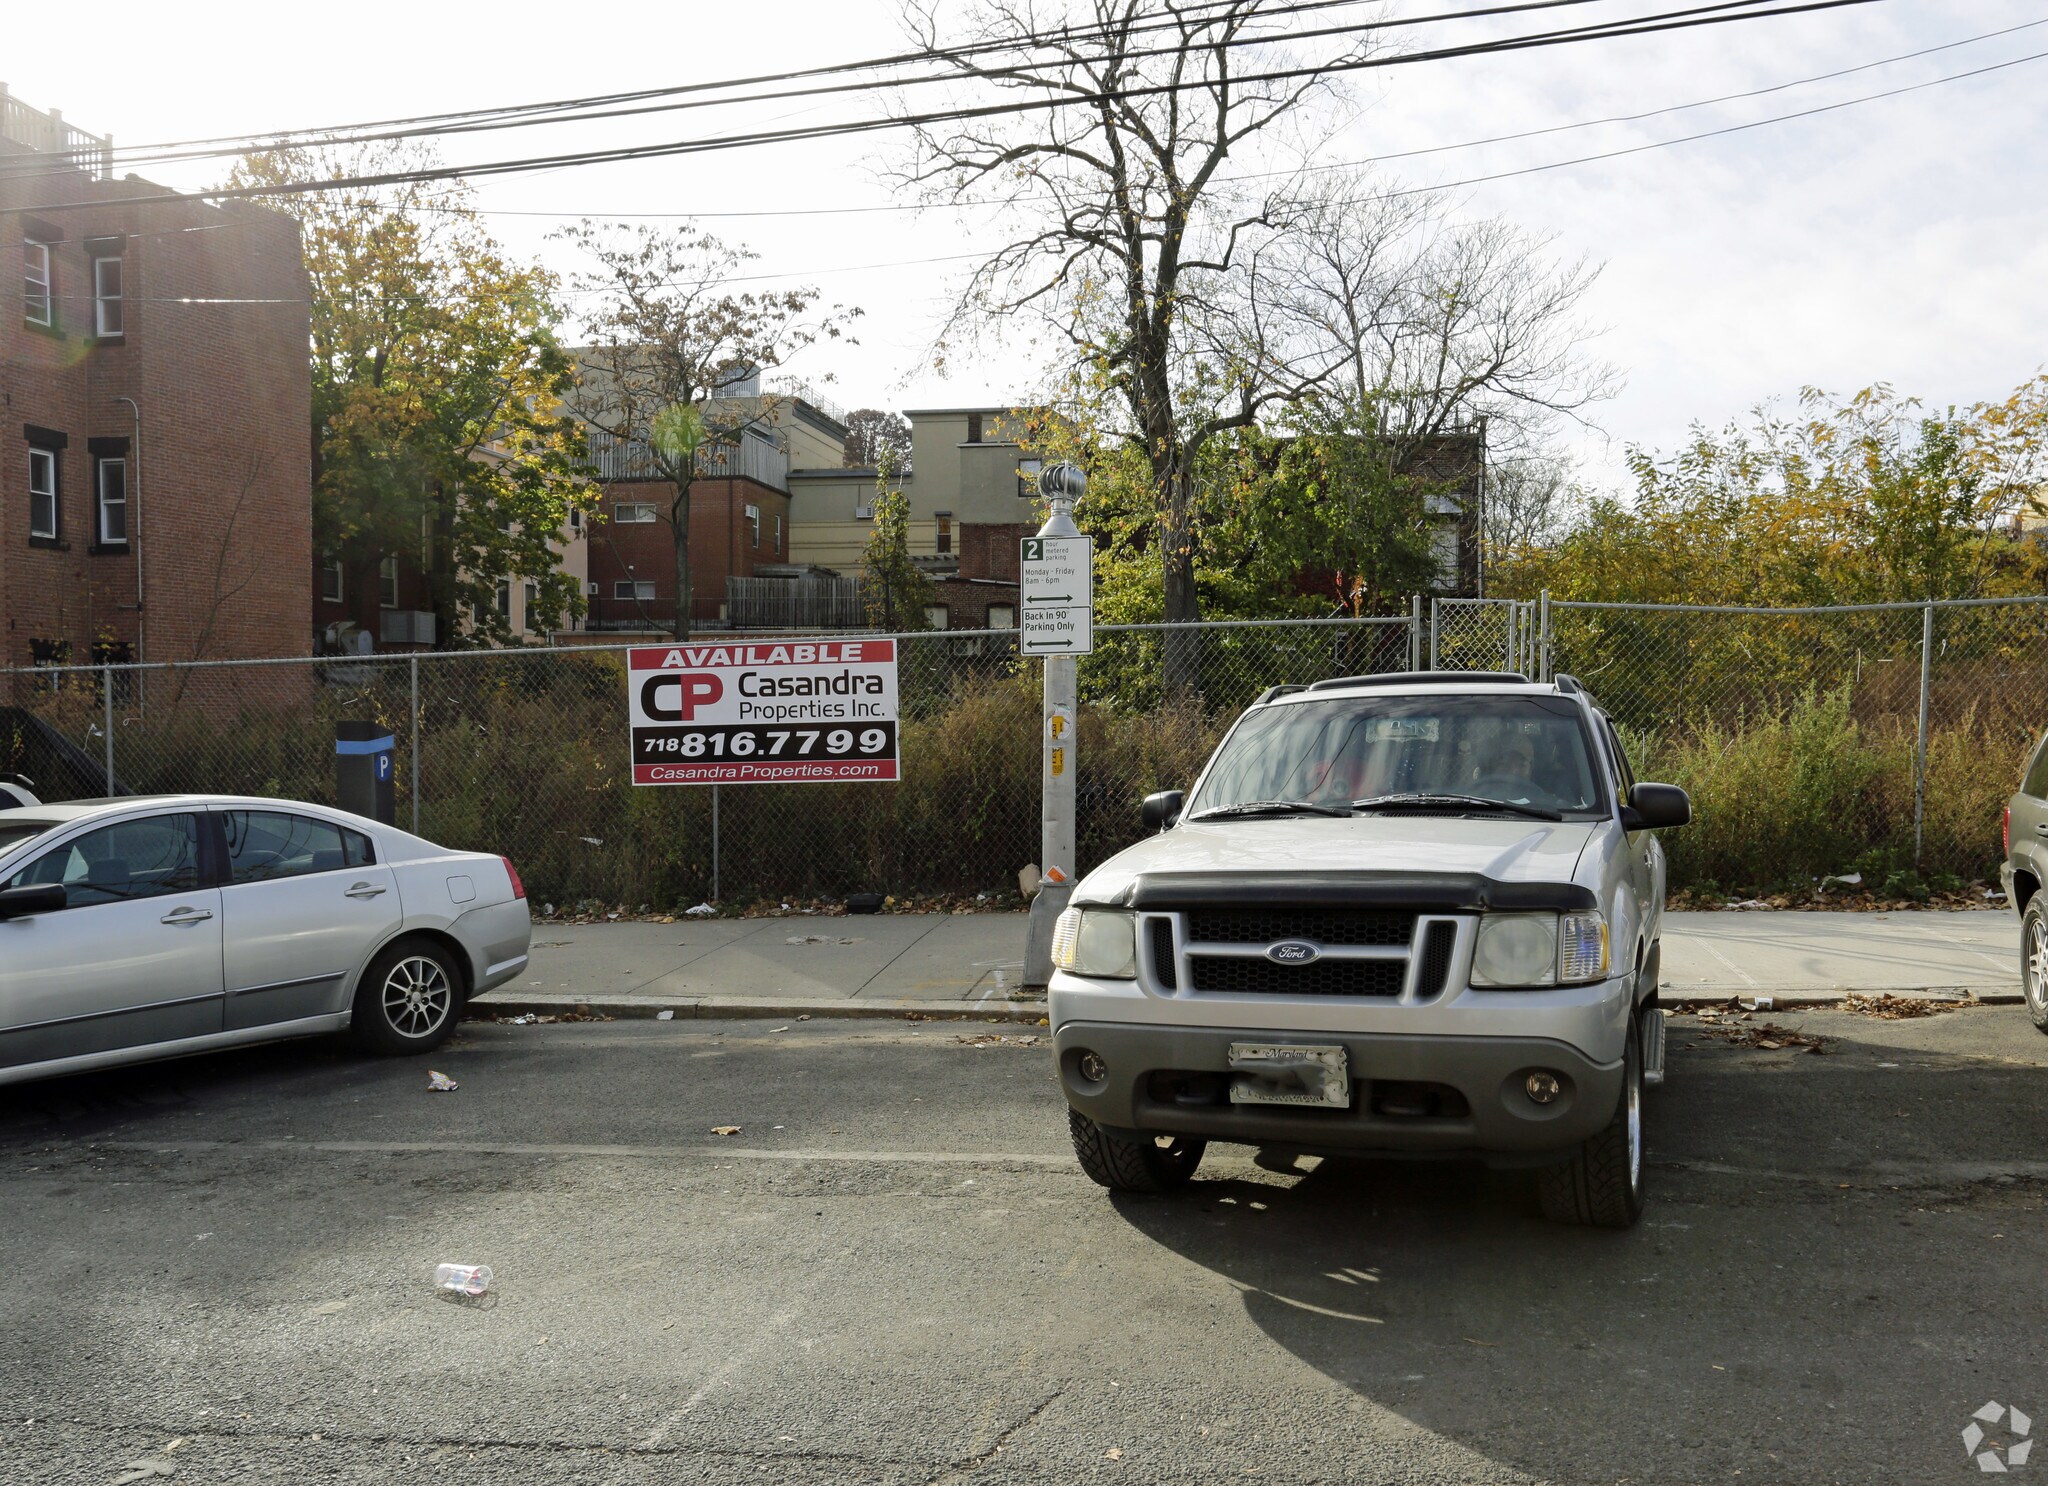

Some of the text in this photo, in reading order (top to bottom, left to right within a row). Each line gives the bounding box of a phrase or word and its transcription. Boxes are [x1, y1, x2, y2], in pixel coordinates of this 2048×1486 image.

[1027, 540, 1038, 559] 2
[1025, 568, 1050, 576] Monday
[1055, 567, 1075, 575] Friday
[1045, 577, 1060, 585] 6pm
[1025, 611, 1044, 620] Back
[1046, 611, 1054, 619] In
[1025, 621, 1075, 632] Parking Only
[661, 643, 863, 668] AVAILABLE
[738, 669, 884, 698] Casandra
[640, 672, 724, 722] CP
[739, 699, 885, 722] Properties Inc.
[644, 728, 887, 757] 718 816.7799
[380, 755, 389, 778] P
[1279, 946, 1306, 958] Ford
[1265, 1048, 1309, 1058] Maryland
